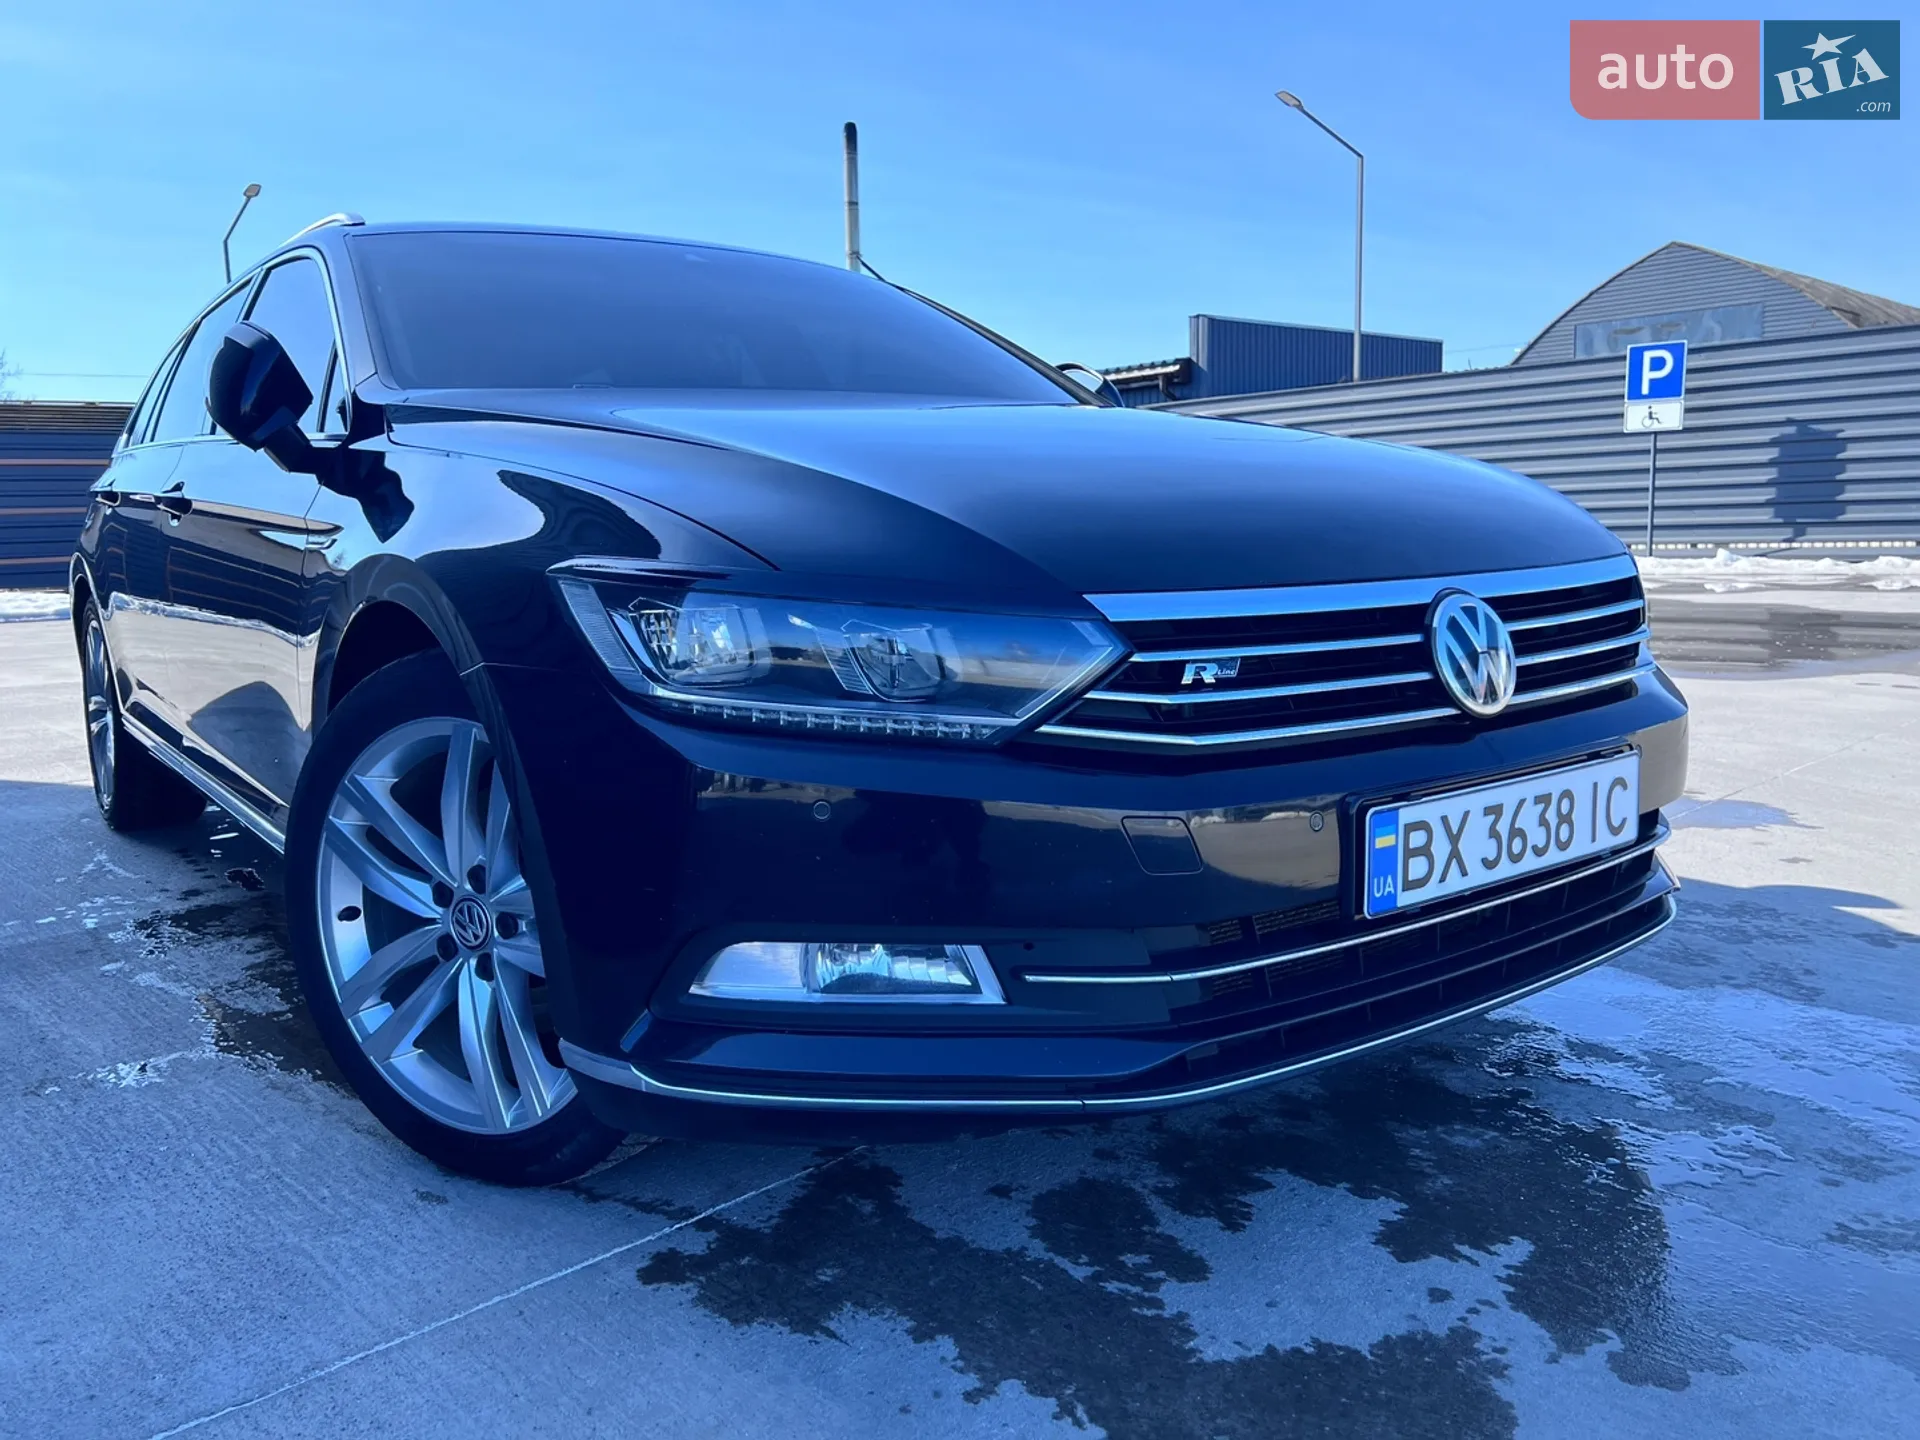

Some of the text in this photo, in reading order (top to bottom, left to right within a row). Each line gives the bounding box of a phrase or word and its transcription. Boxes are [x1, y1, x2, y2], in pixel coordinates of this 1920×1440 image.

[1641, 349, 1674, 395] P
[1402, 777, 1628, 892] BX 3638 IC
[1373, 875, 1395, 898] UA
